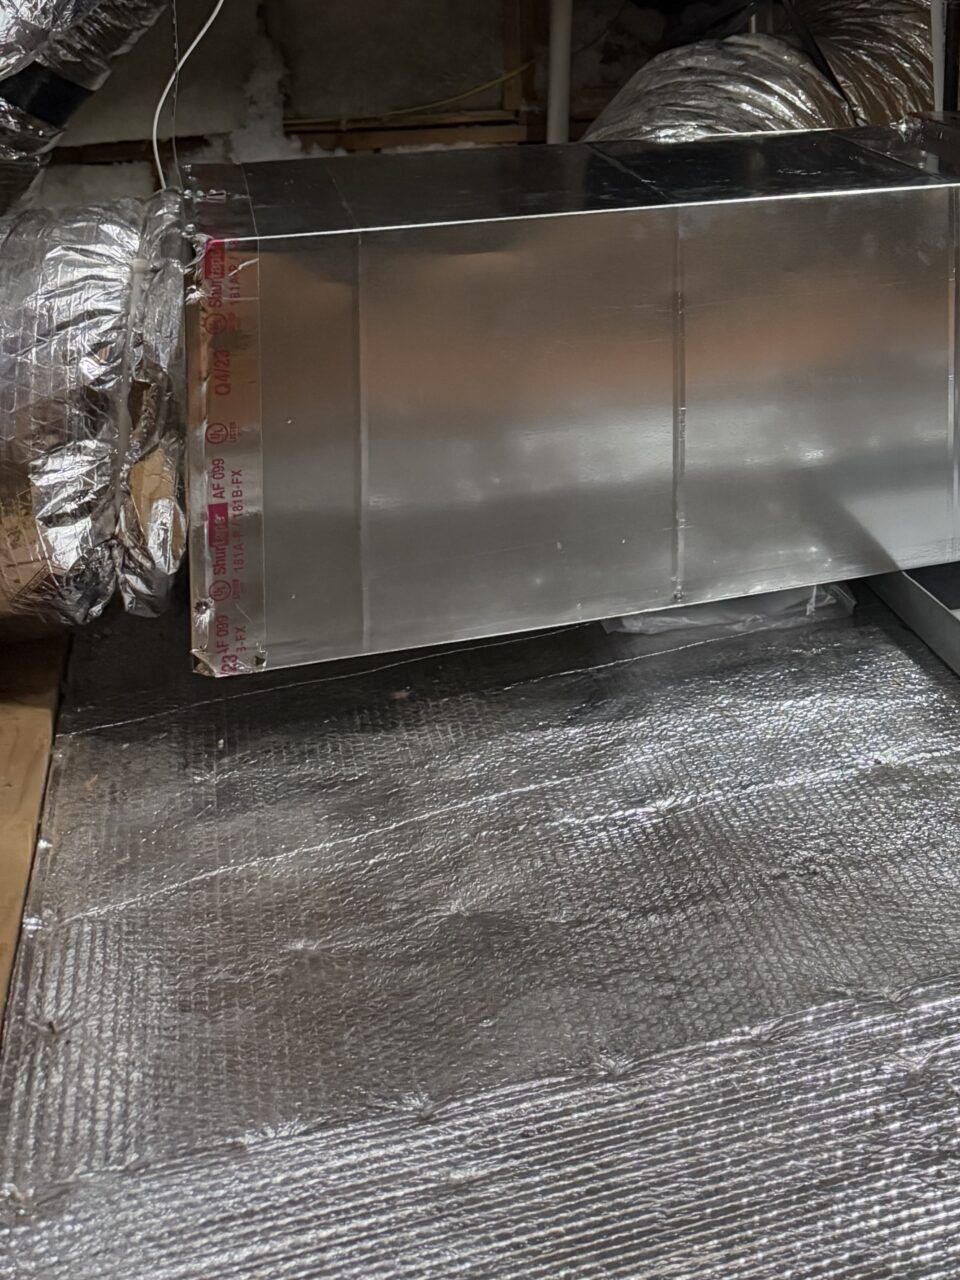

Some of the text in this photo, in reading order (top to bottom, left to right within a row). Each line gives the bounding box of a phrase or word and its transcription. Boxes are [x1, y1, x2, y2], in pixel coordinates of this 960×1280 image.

[215, 347, 231, 396] Q4/23
[212, 458, 225, 480] 099
[213, 483, 226, 499] AF
[232, 469, 244, 518] 181B-FX
[216, 615, 229, 637] 099
